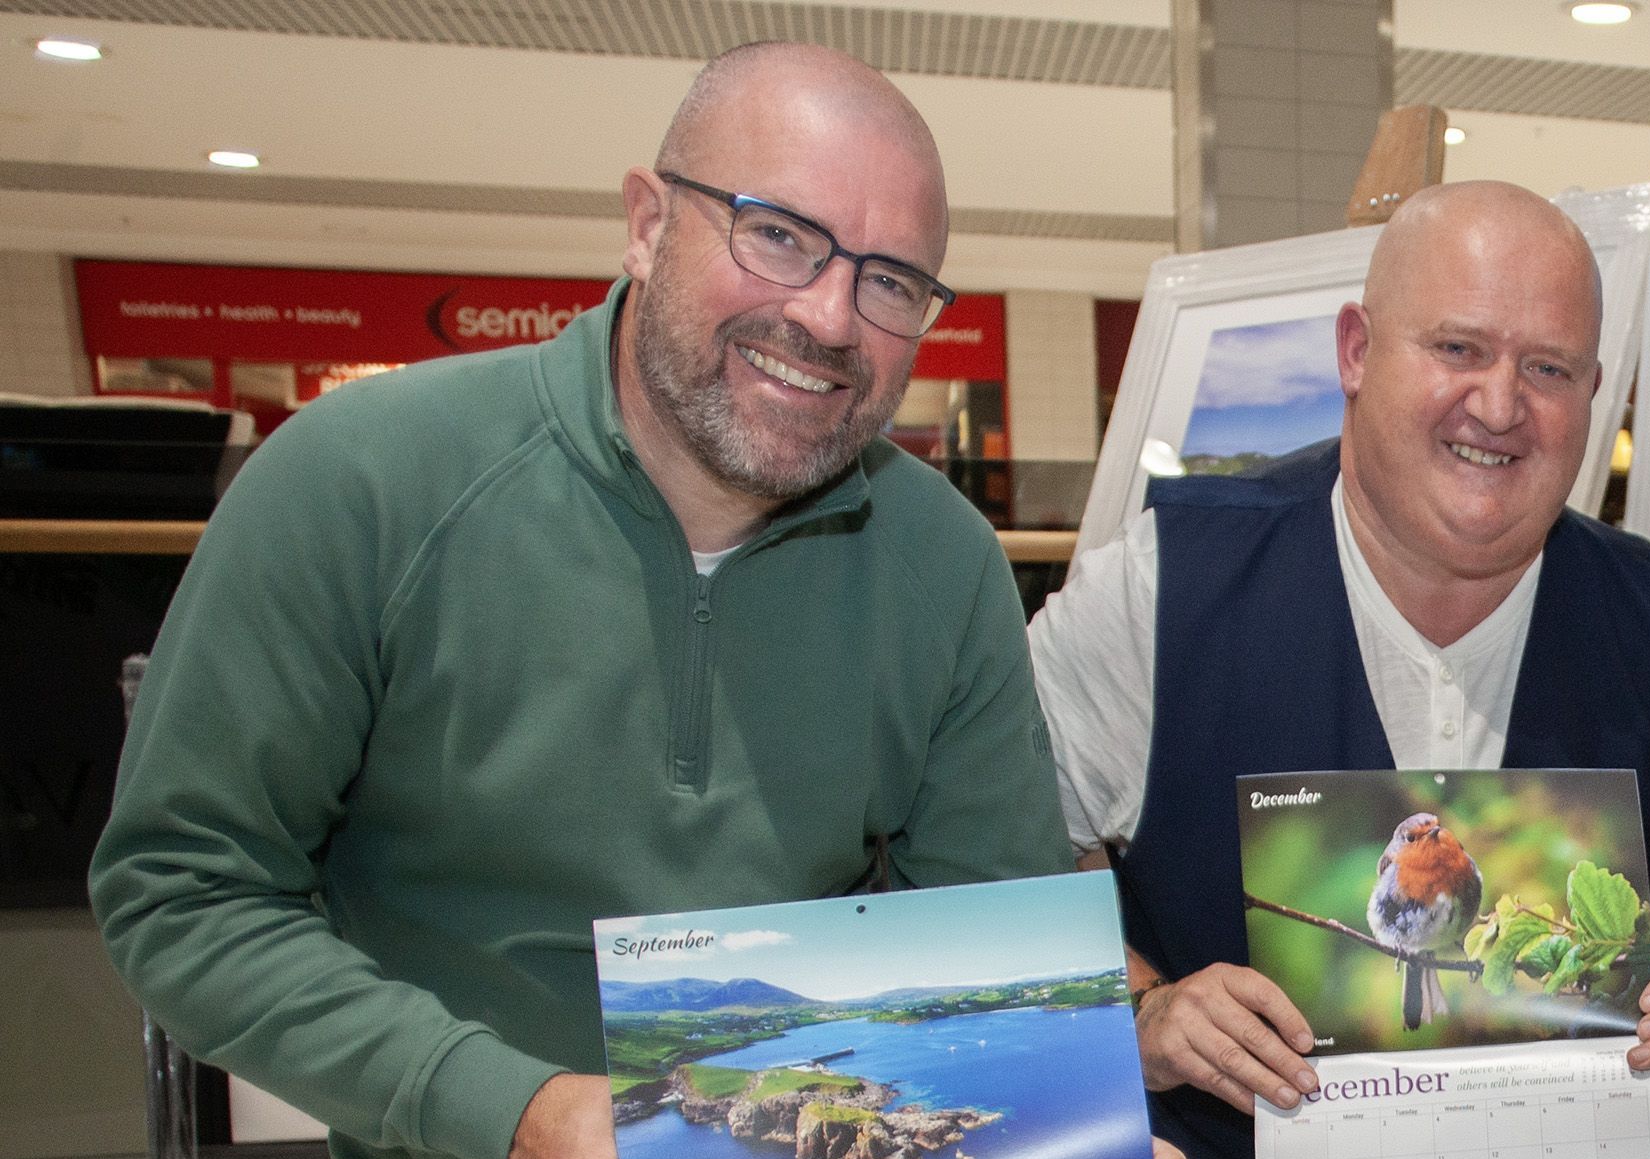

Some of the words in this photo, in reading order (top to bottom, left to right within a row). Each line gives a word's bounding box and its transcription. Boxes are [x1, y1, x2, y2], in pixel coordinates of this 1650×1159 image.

[121, 302, 199, 319] toiletries
[220, 303, 279, 321] health
[296, 305, 361, 328] beauty
[1250, 786, 1322, 809] December
[613, 929, 714, 960] September
[1457, 1080, 1488, 1091] others
[1490, 1077, 1508, 1089] will
[1511, 1076, 1520, 1087] be
[1524, 1072, 1575, 1086] convinced
[1558, 1095, 1574, 1103] Friday
[1608, 1091, 1632, 1099] Saturday
[1444, 1104, 1475, 1112] Wednesday
[1501, 1100, 1525, 1108] Thursday
[1343, 1113, 1364, 1121] Monday
[1396, 1109, 1418, 1117] Tuesday
